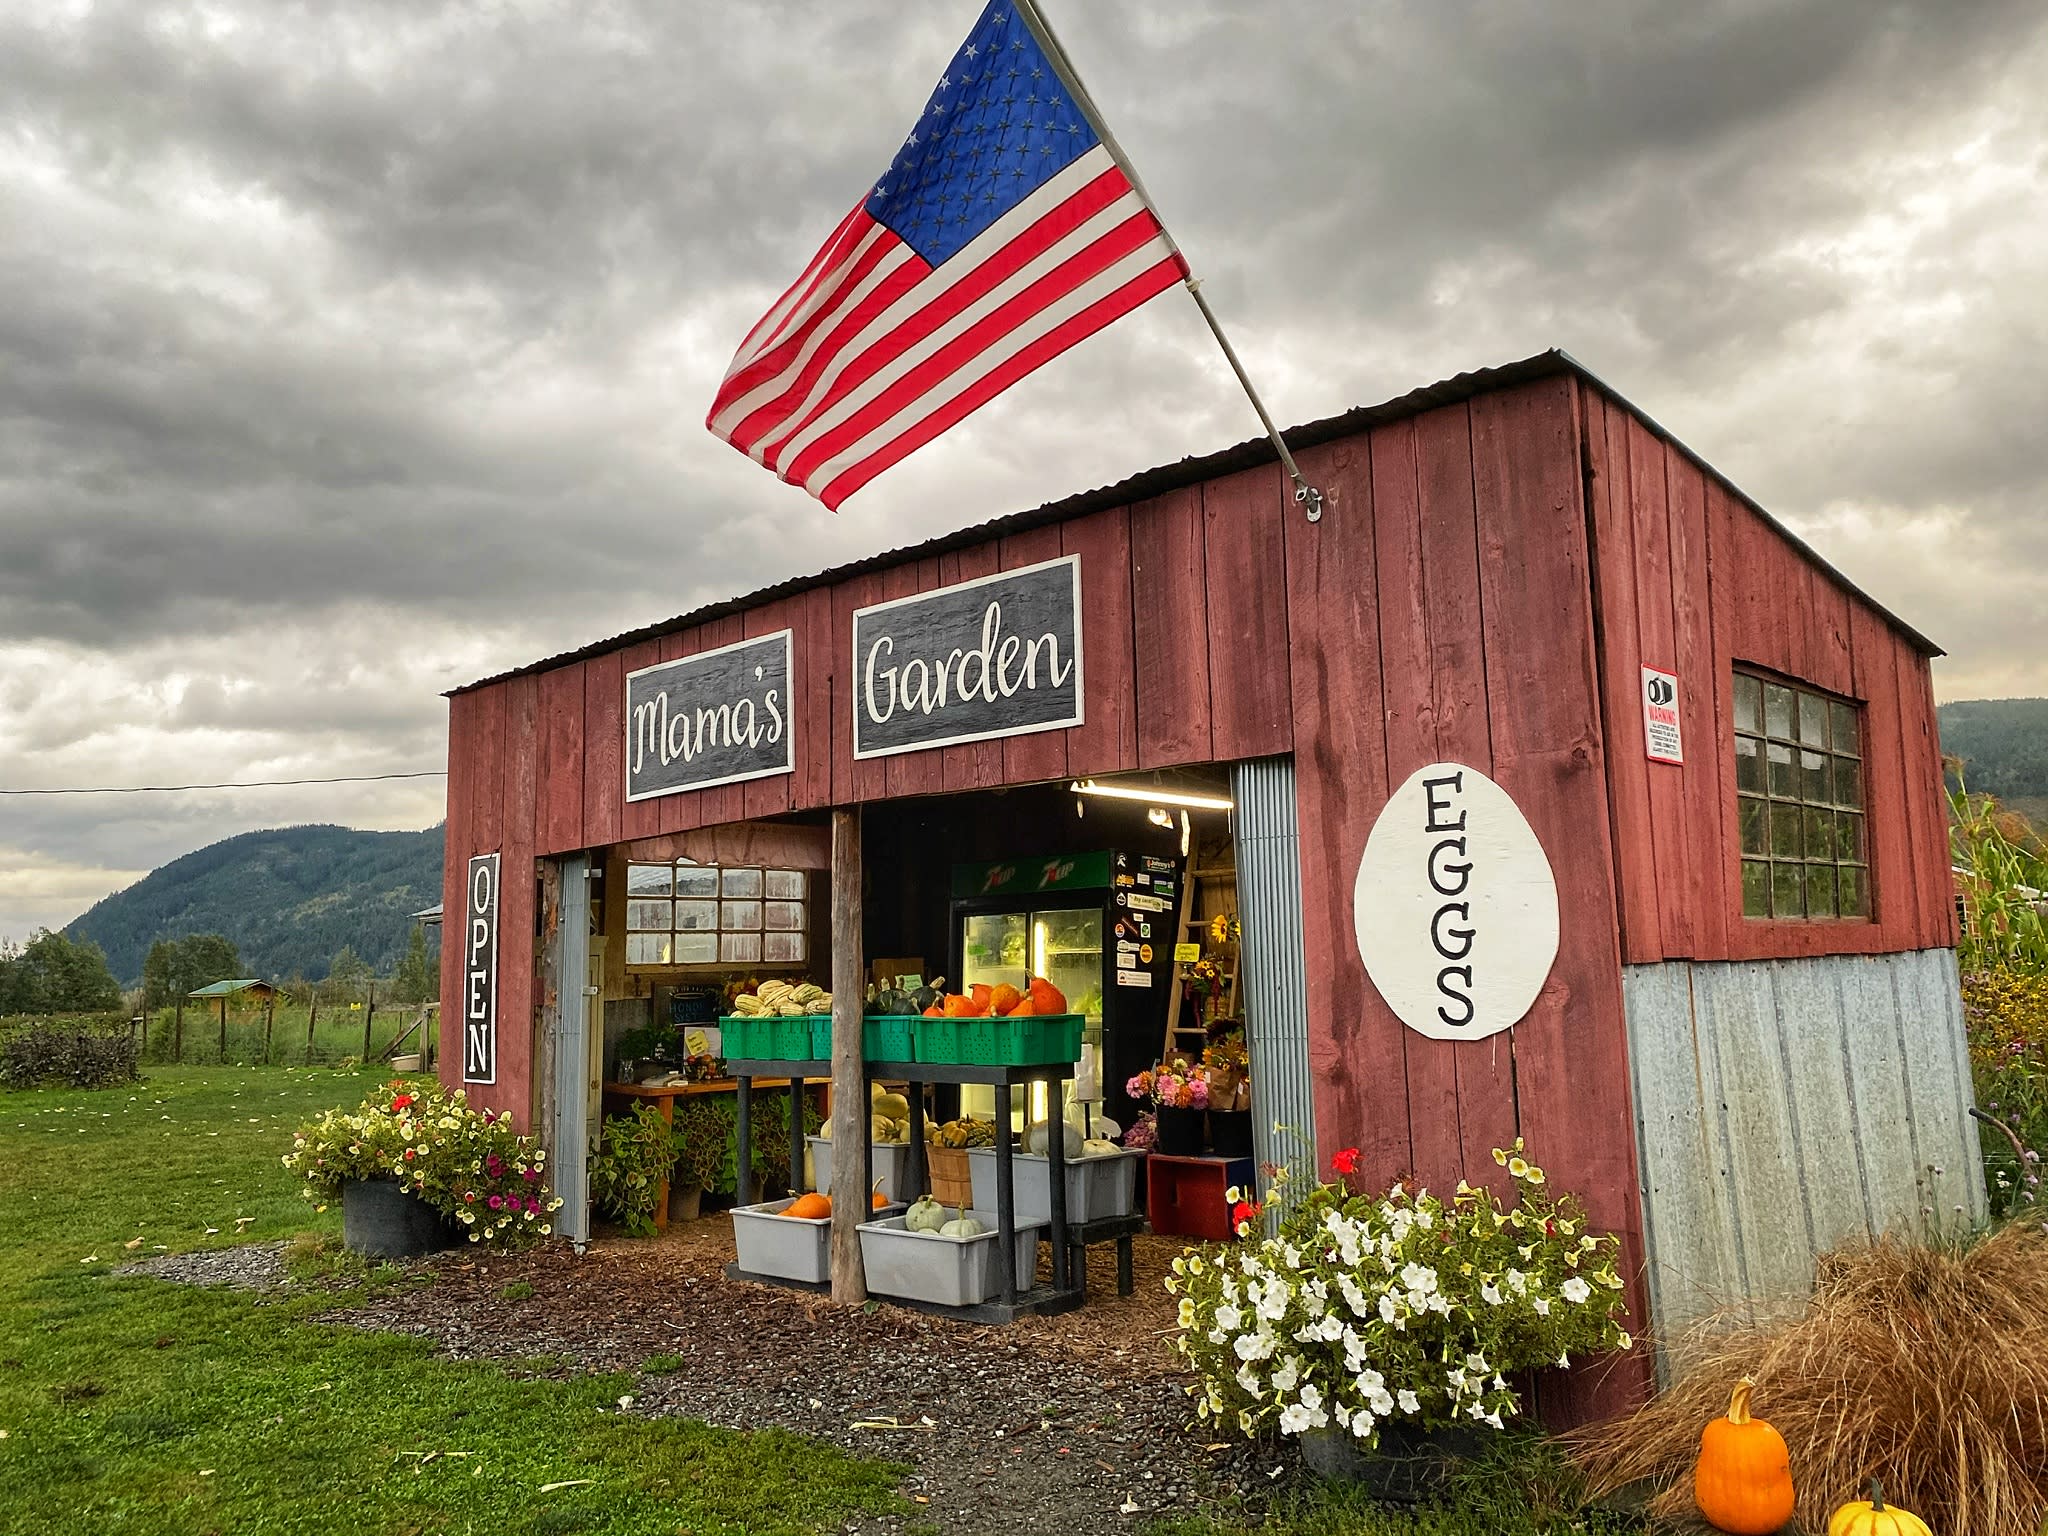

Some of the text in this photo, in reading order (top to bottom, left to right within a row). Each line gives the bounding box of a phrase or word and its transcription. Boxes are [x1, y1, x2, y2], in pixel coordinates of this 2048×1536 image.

[633, 601, 1073, 774] Mama's Garden
[1648, 705, 1676, 726] WARNING
[468, 865, 491, 1073] OPEN
[1423, 771, 1476, 1027] EGGS
